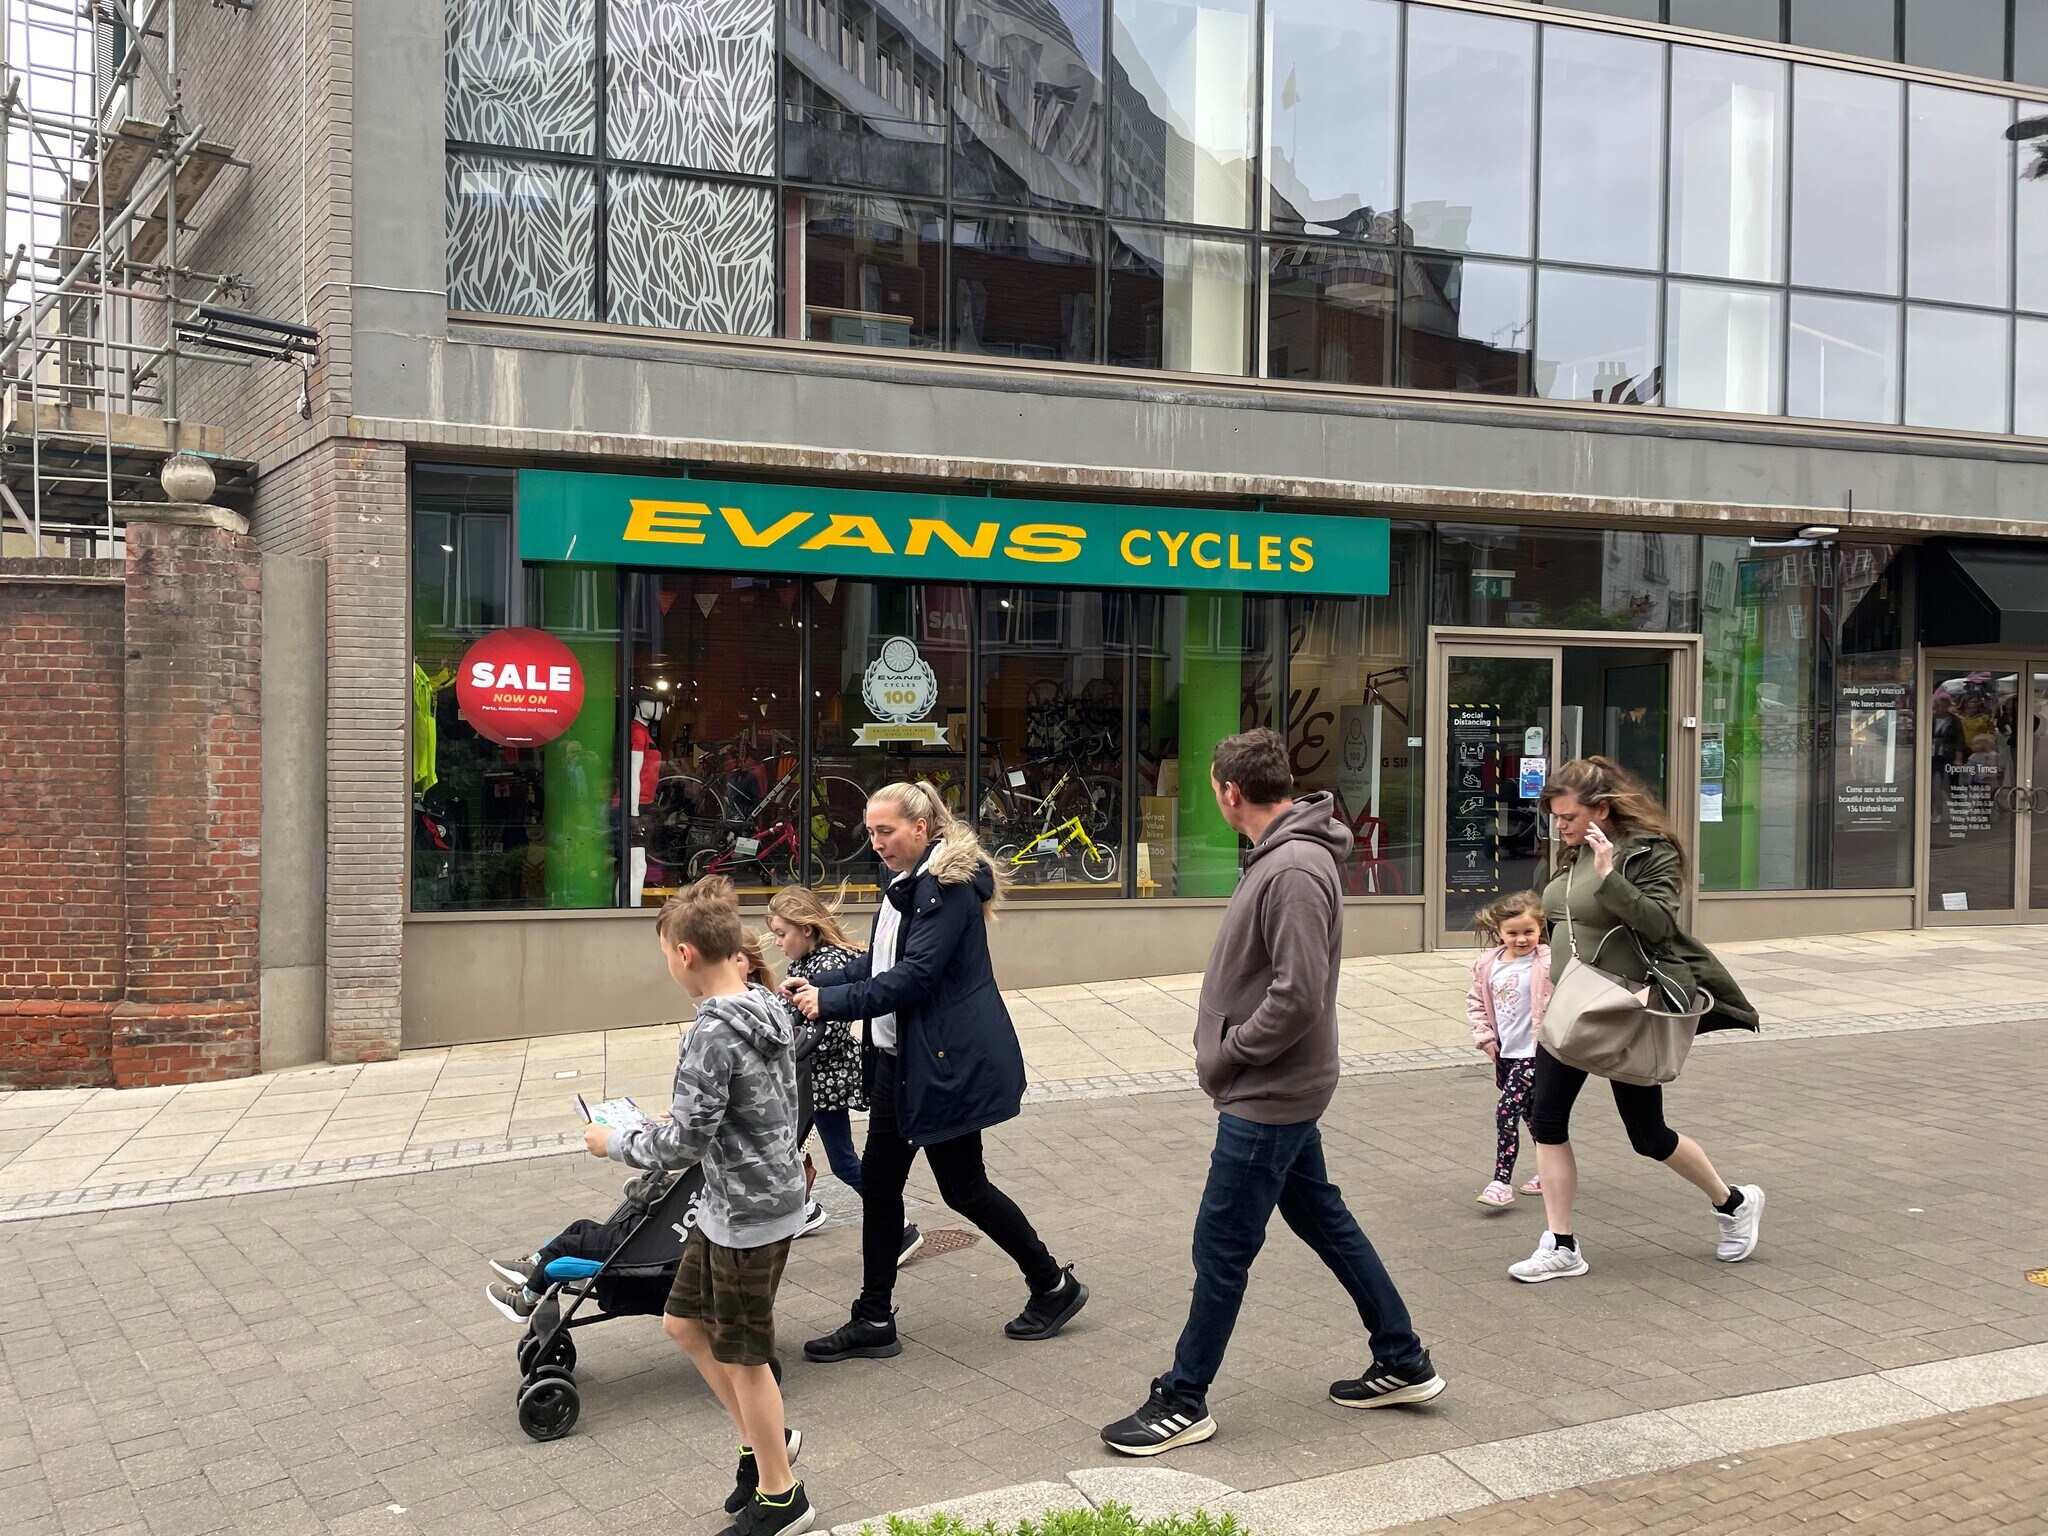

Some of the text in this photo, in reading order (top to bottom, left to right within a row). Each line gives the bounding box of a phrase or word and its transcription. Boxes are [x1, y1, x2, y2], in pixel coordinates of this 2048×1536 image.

[623, 498, 1315, 573] EVANS CYCLES
[471, 662, 571, 691] SALE
[1843, 686, 1905, 696] paula gundry interiors
[493, 694, 547, 704] NOW ON
[884, 691, 916, 704] 100
[1850, 700, 1860, 708] We
[1861, 700, 1874, 708] have
[1462, 711, 1483, 719] Social
[1454, 719, 1491, 727] Distancing
[1945, 764, 1998, 775] Opening Times
[1838, 795, 1863, 803] beautiful
[1146, 812, 1166, 822] Great
[1147, 821, 1165, 830] value
[1147, 830, 1164, 839] bikes
